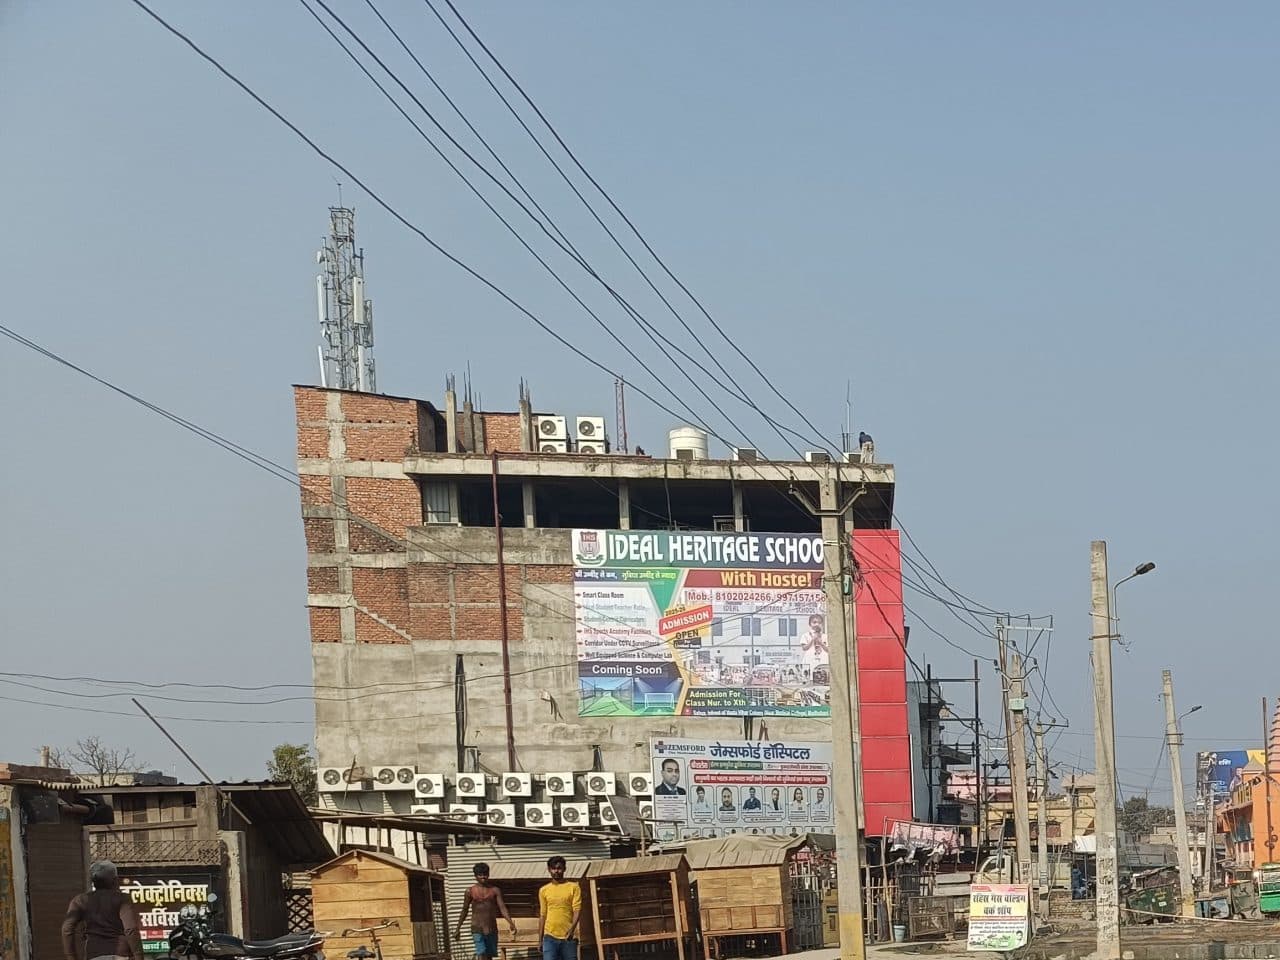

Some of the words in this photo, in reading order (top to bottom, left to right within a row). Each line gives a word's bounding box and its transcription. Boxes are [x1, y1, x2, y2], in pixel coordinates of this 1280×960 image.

[608, 534, 664, 564] IDEAL
[668, 535, 760, 565] HERITAGE
[765, 537, 824, 565] SCHOO
[720, 571, 755, 586] With
[661, 610, 710, 630] ADMISSION
[675, 629, 699, 639] OPEN
[592, 664, 633, 676] Coming
[636, 664, 662, 674] Soon
[689, 690, 727, 698] Admission
[728, 690, 741, 698] For
[709, 742, 761, 759] जेम्सफोर्ड
[762, 743, 811, 760] हॉस्पिटल
[120, 880, 209, 906] लेक्ट्रोनिक्स
[139, 907, 180, 927] सर्विस
